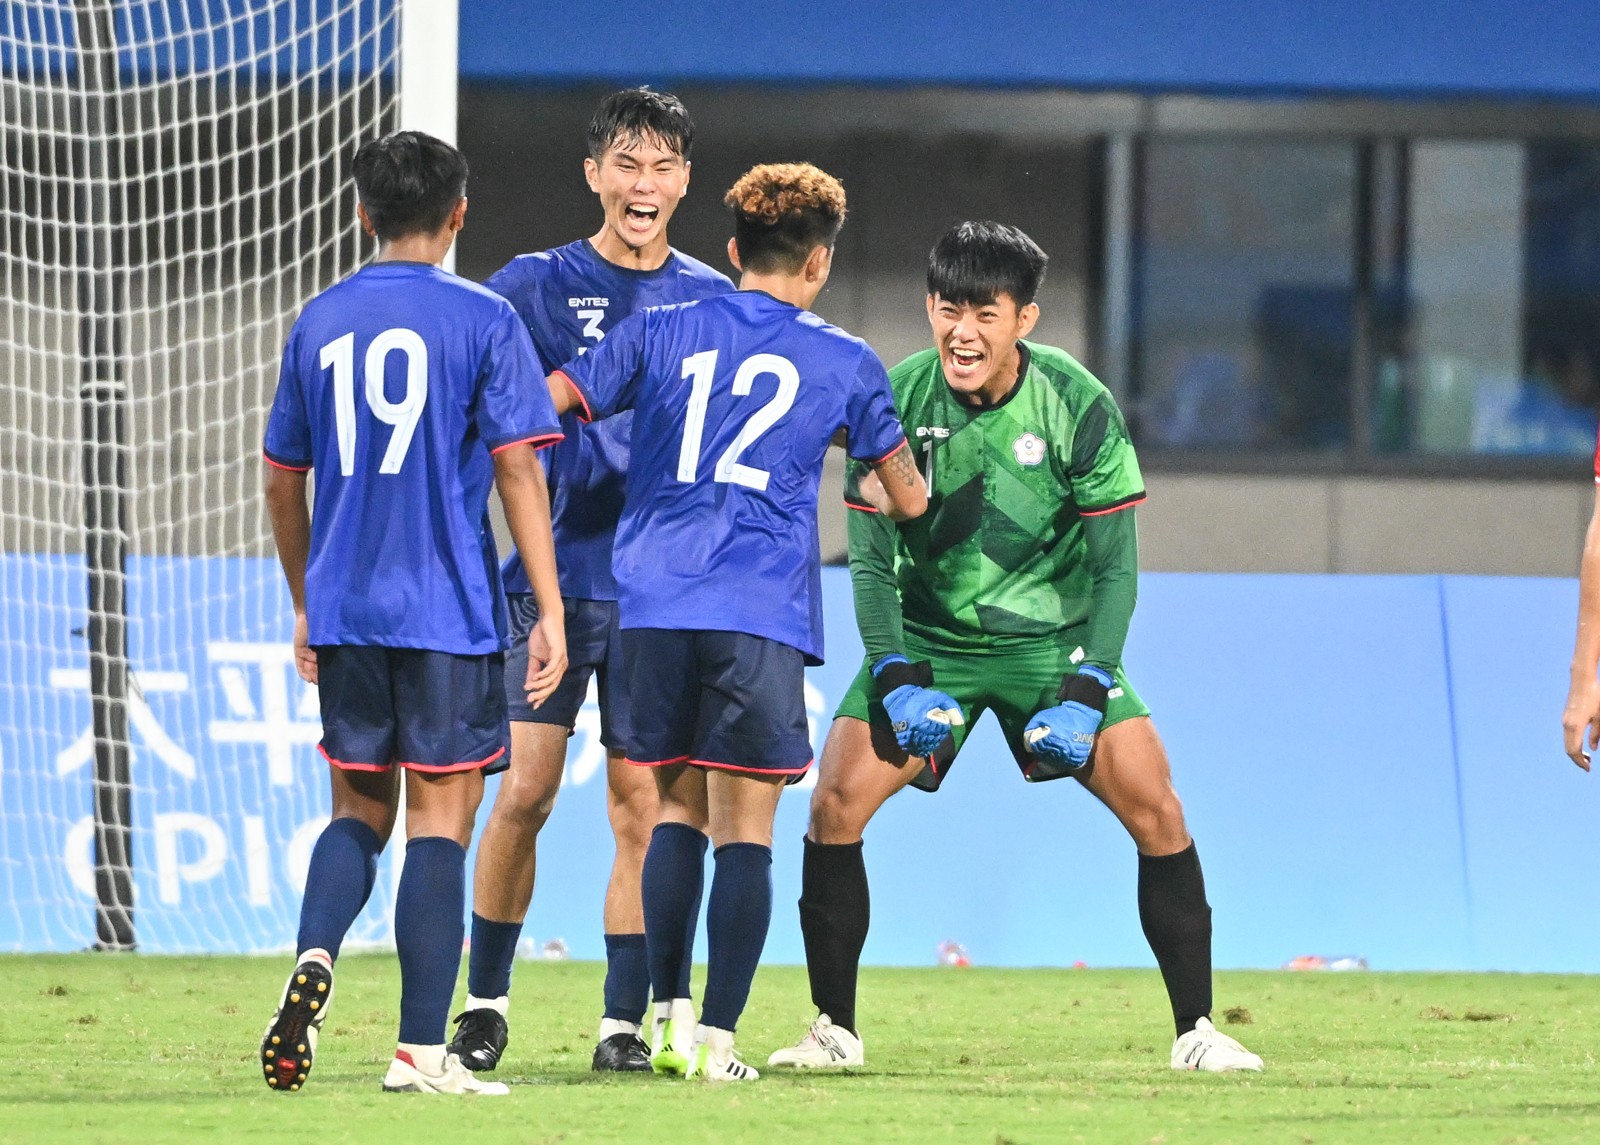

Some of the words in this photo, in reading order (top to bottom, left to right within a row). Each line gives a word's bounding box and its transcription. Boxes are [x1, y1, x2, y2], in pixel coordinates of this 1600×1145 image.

[568, 297, 610, 307] ENTES
[576, 309, 606, 357] 3
[319, 327, 429, 477] 19
[676, 349, 800, 492] 12
[915, 426, 950, 438] ENTES
[922, 439, 934, 498] 1
